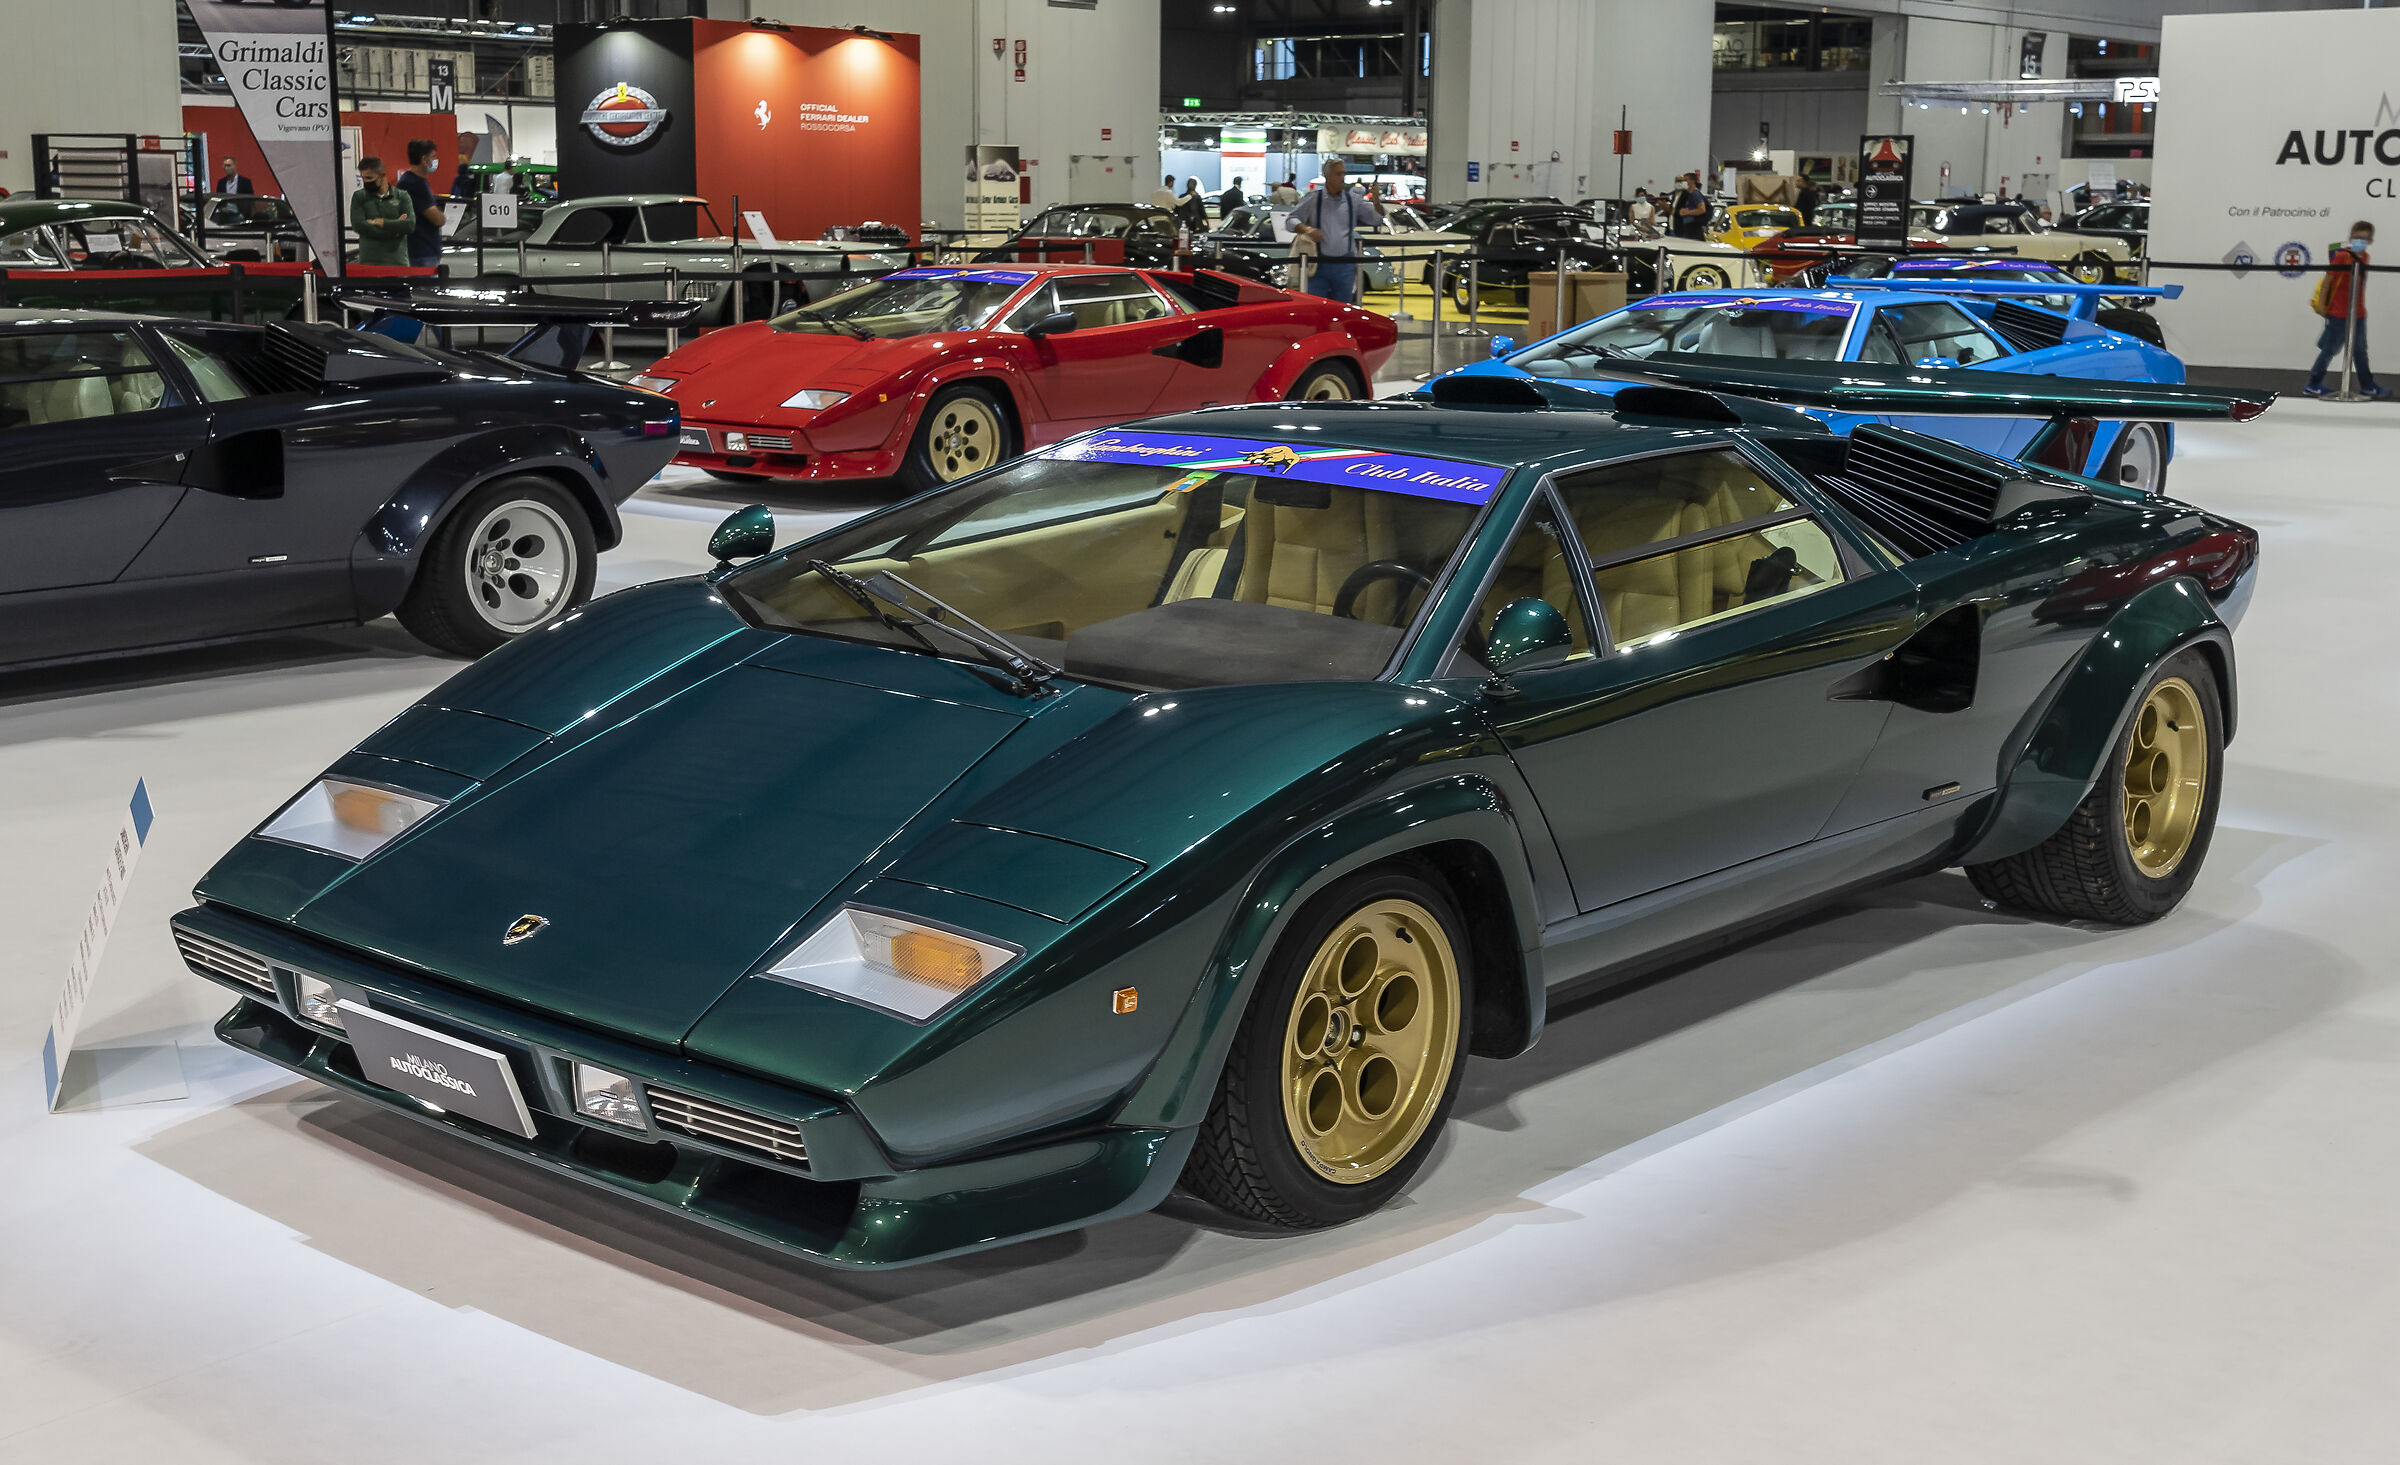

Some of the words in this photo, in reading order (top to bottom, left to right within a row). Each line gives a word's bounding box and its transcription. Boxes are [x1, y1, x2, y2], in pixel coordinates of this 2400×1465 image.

[219, 40, 324, 63] Grimaldi
[242, 68, 327, 91] Classic
[437, 65, 449, 76] 13
[276, 96, 328, 118] Cars
[431, 85, 452, 111] M
[800, 103, 838, 113] OFFICIAL
[312, 124, 329, 132] (PV)
[800, 112, 835, 121] FERRARI
[836, 114, 869, 124] DEALER
[2275, 128, 2400, 166] AUTO
[489, 204, 510, 216] G10
[2228, 206, 2250, 217] Con
[2252, 206, 2260, 217] il
[2262, 207, 2316, 218] Patrocinio
[2319, 207, 2331, 218] di
[1088, 439, 1212, 457] Lamborghini
[1345, 462, 1411, 480] Club
[1406, 470, 1490, 492] Italia
[406, 1052, 449, 1076] MILANO
[390, 1056, 478, 1097] AUTOCLASSICA
